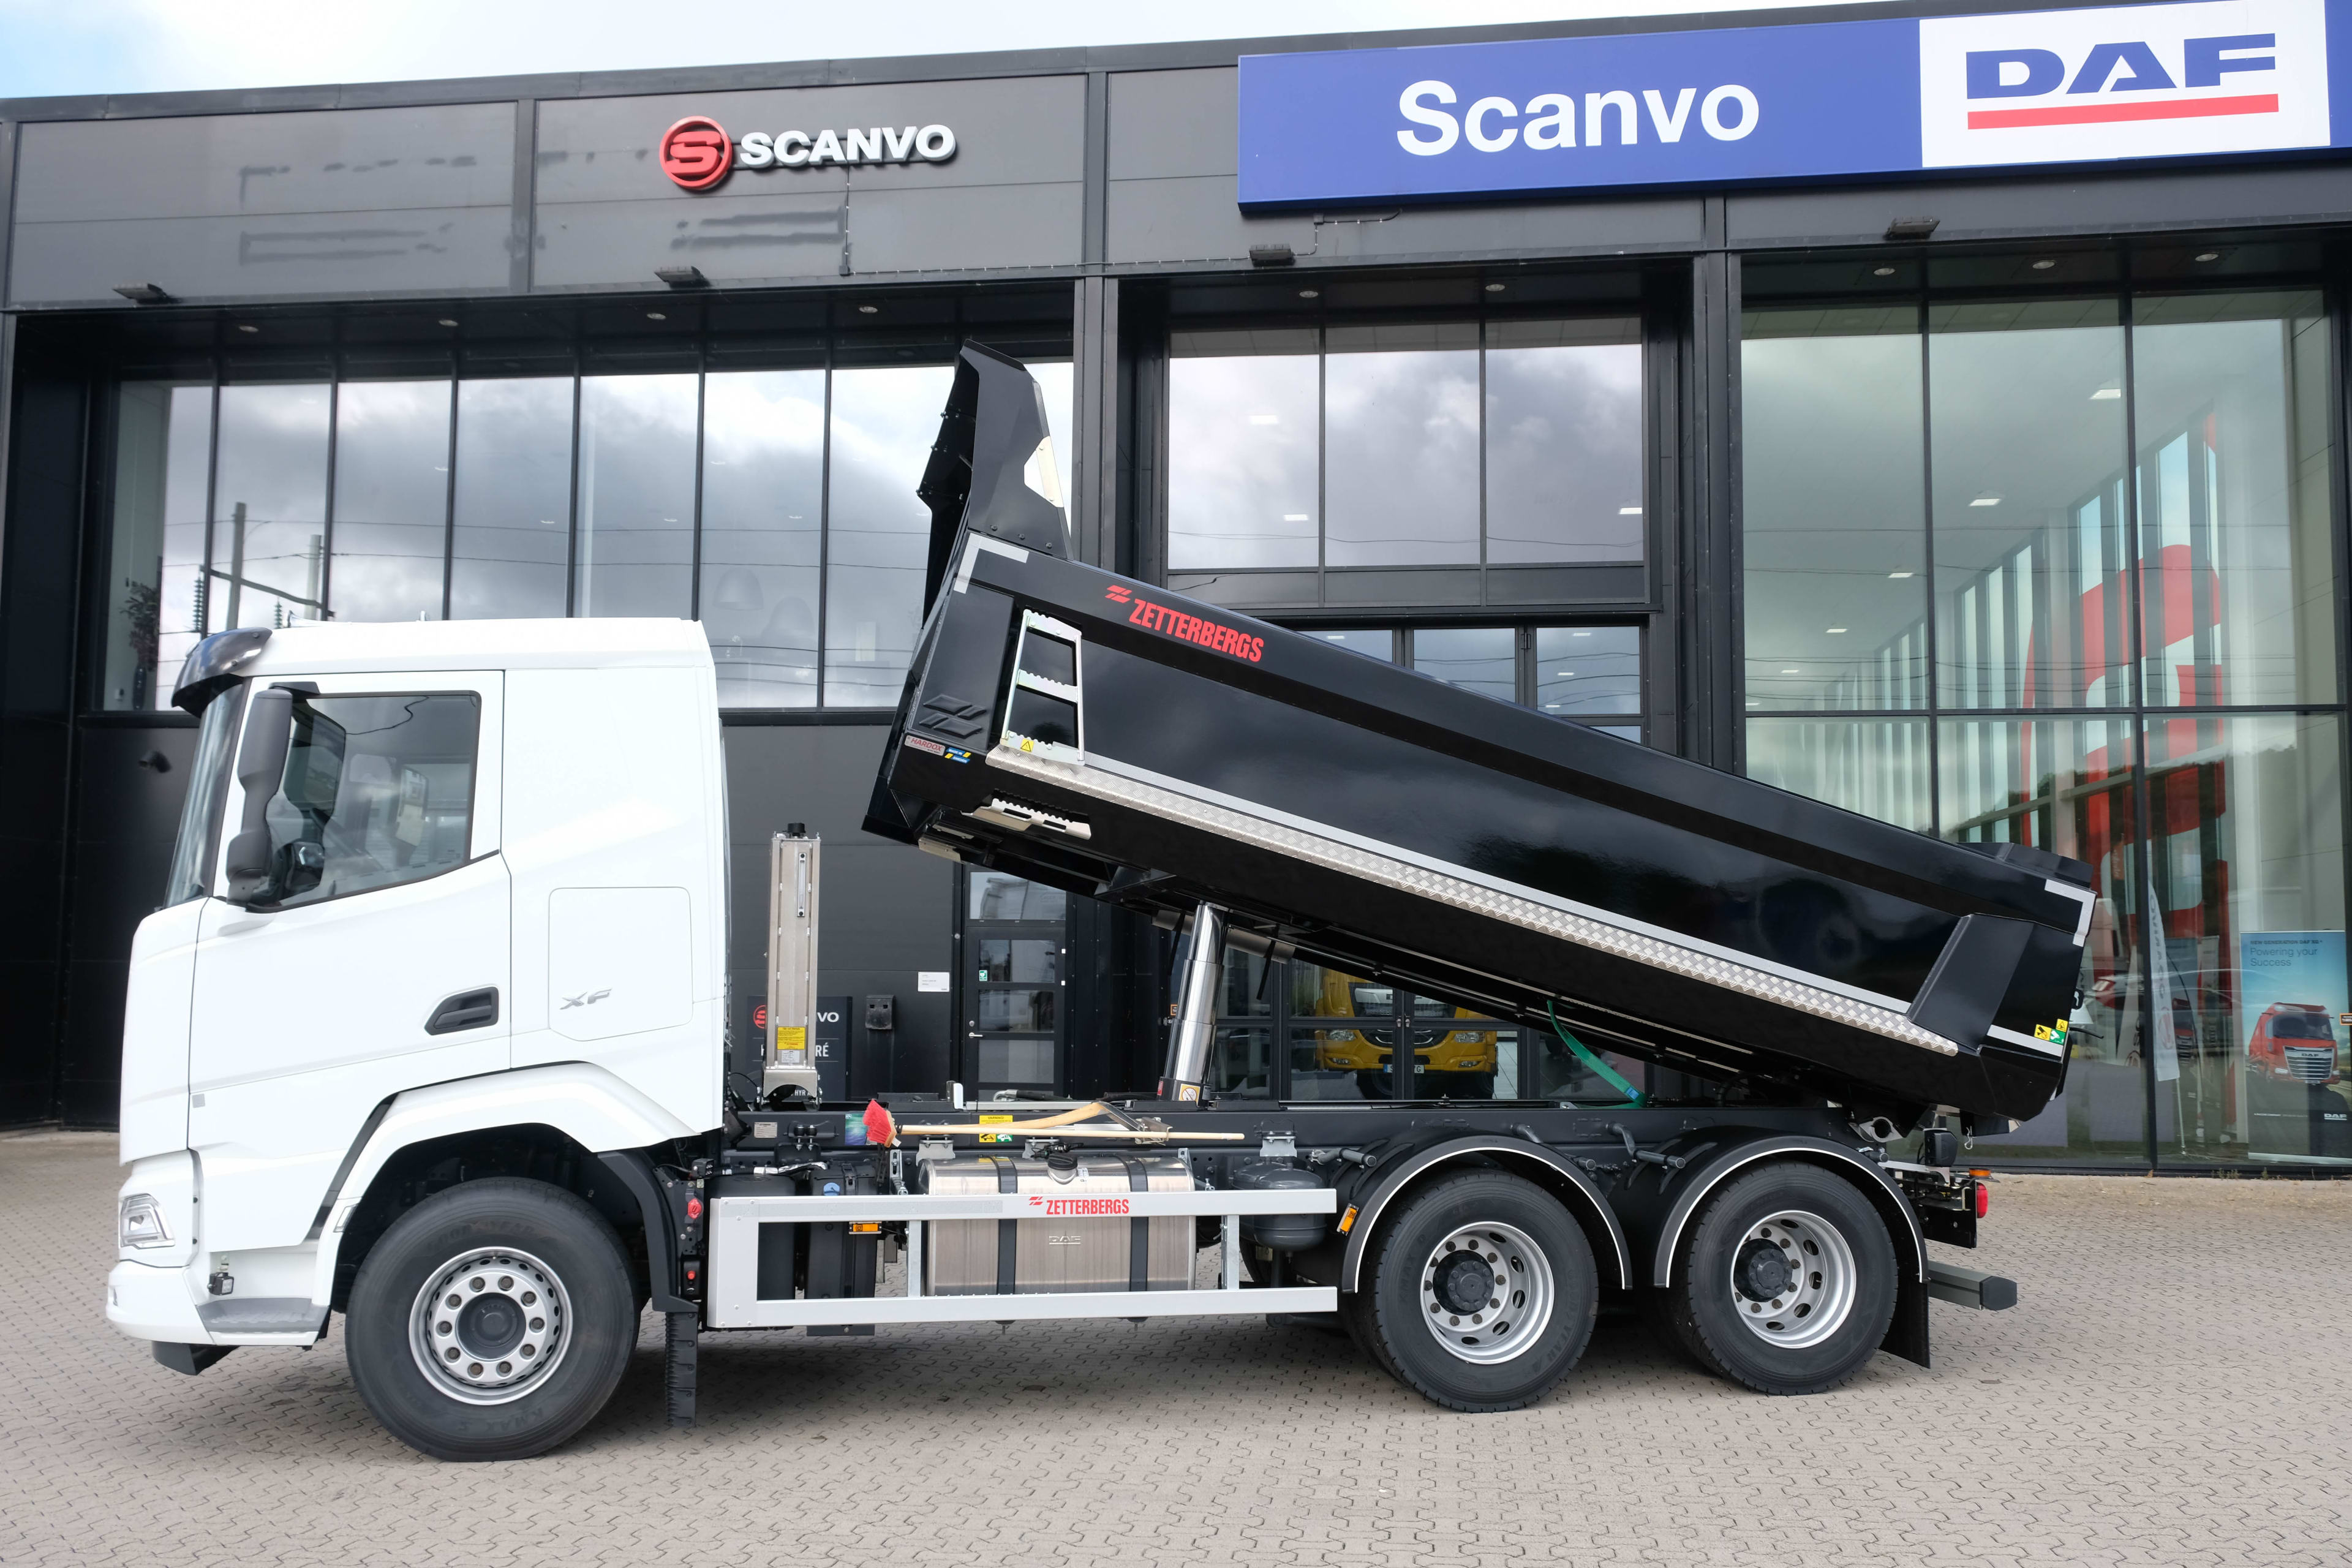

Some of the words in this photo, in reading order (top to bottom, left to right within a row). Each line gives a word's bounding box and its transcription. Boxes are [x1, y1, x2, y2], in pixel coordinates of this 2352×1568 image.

[1966, 33, 2276, 99] DAF
[1396, 80, 1759, 157] Scanvo
[739, 124, 957, 169] SCANVO
[1129, 598, 1264, 663] ZETTERBERGS
[911, 738, 942, 752] HARDOX
[2250, 948, 2294, 957] Powering
[2297, 949, 2318, 957] your
[2250, 957, 2292, 967] Success
[559, 987, 612, 1010] XF
[1046, 1199, 1129, 1215] ZETTERBERGS
